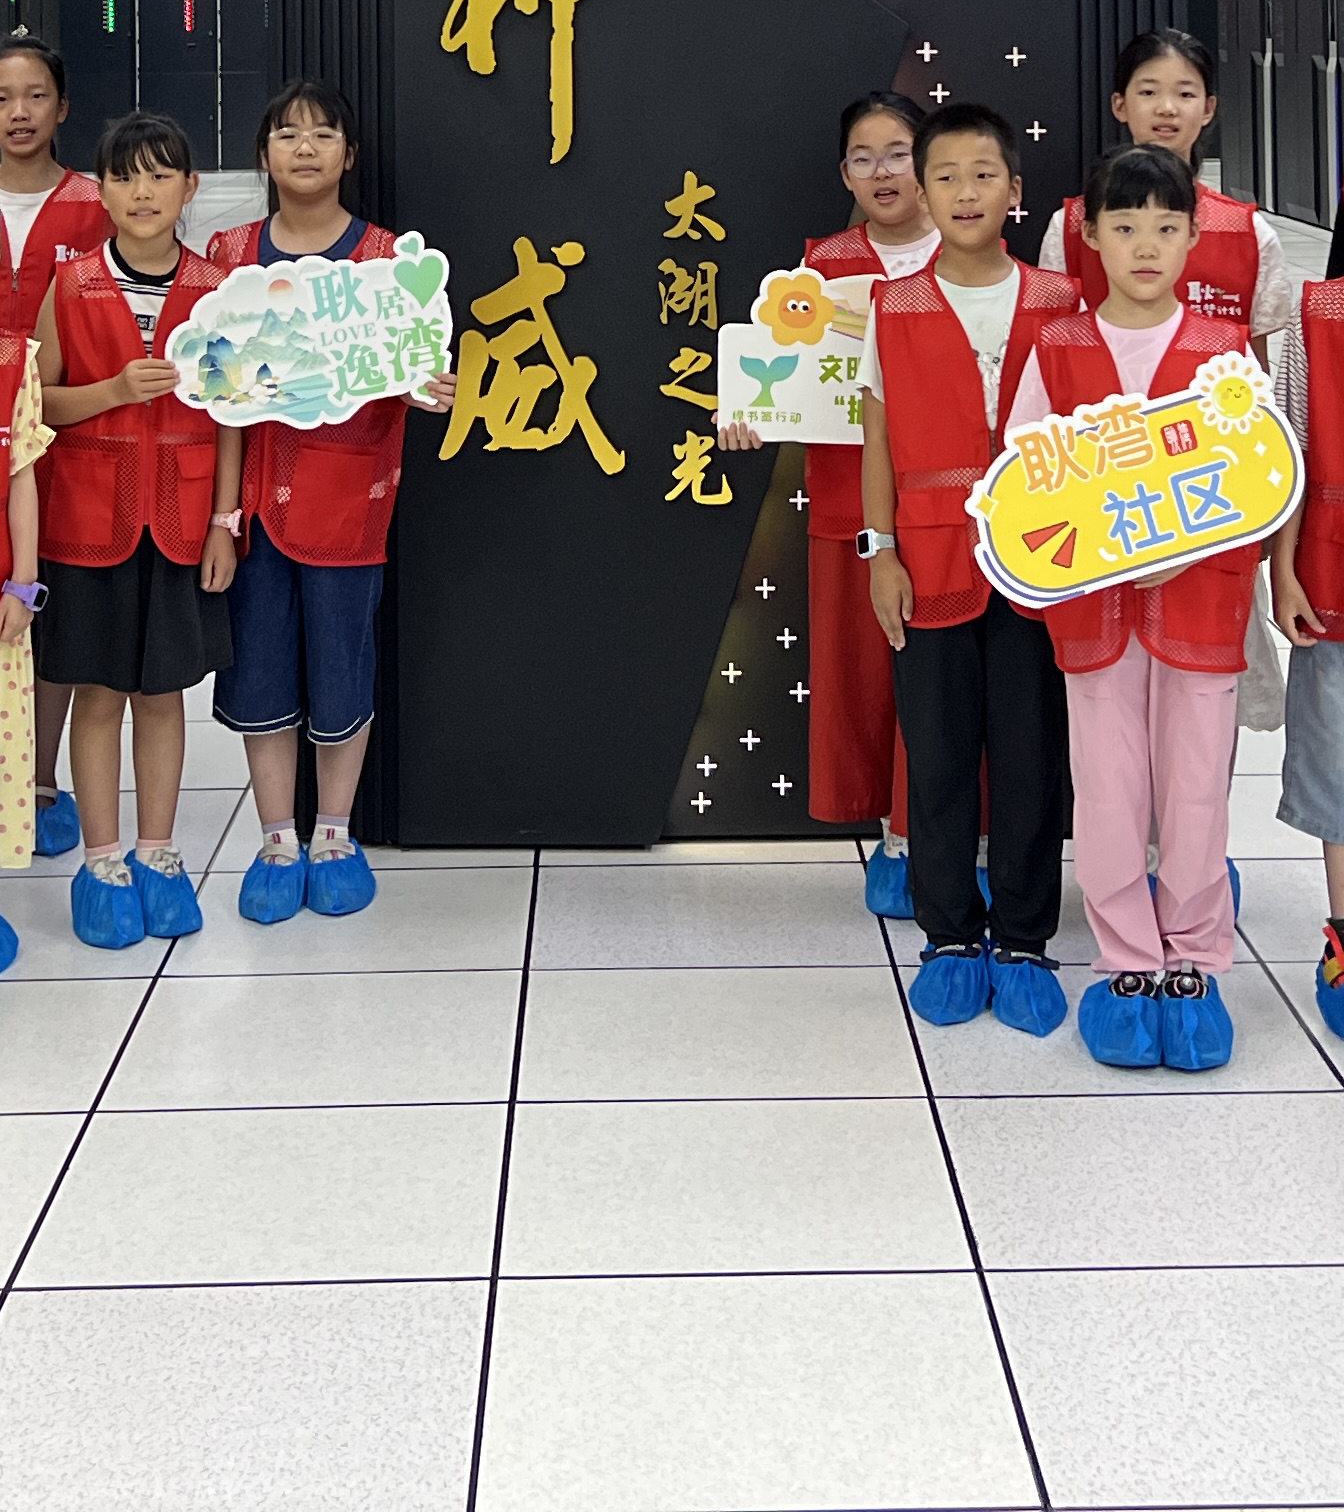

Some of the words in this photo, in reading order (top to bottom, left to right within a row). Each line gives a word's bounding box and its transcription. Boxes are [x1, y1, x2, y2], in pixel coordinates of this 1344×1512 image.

[320, 322, 377, 348] LOVE
[658, 170, 734, 506] 太湖之光
[1014, 402, 1154, 493] 耿湾
[1103, 461, 1242, 555] 社区
